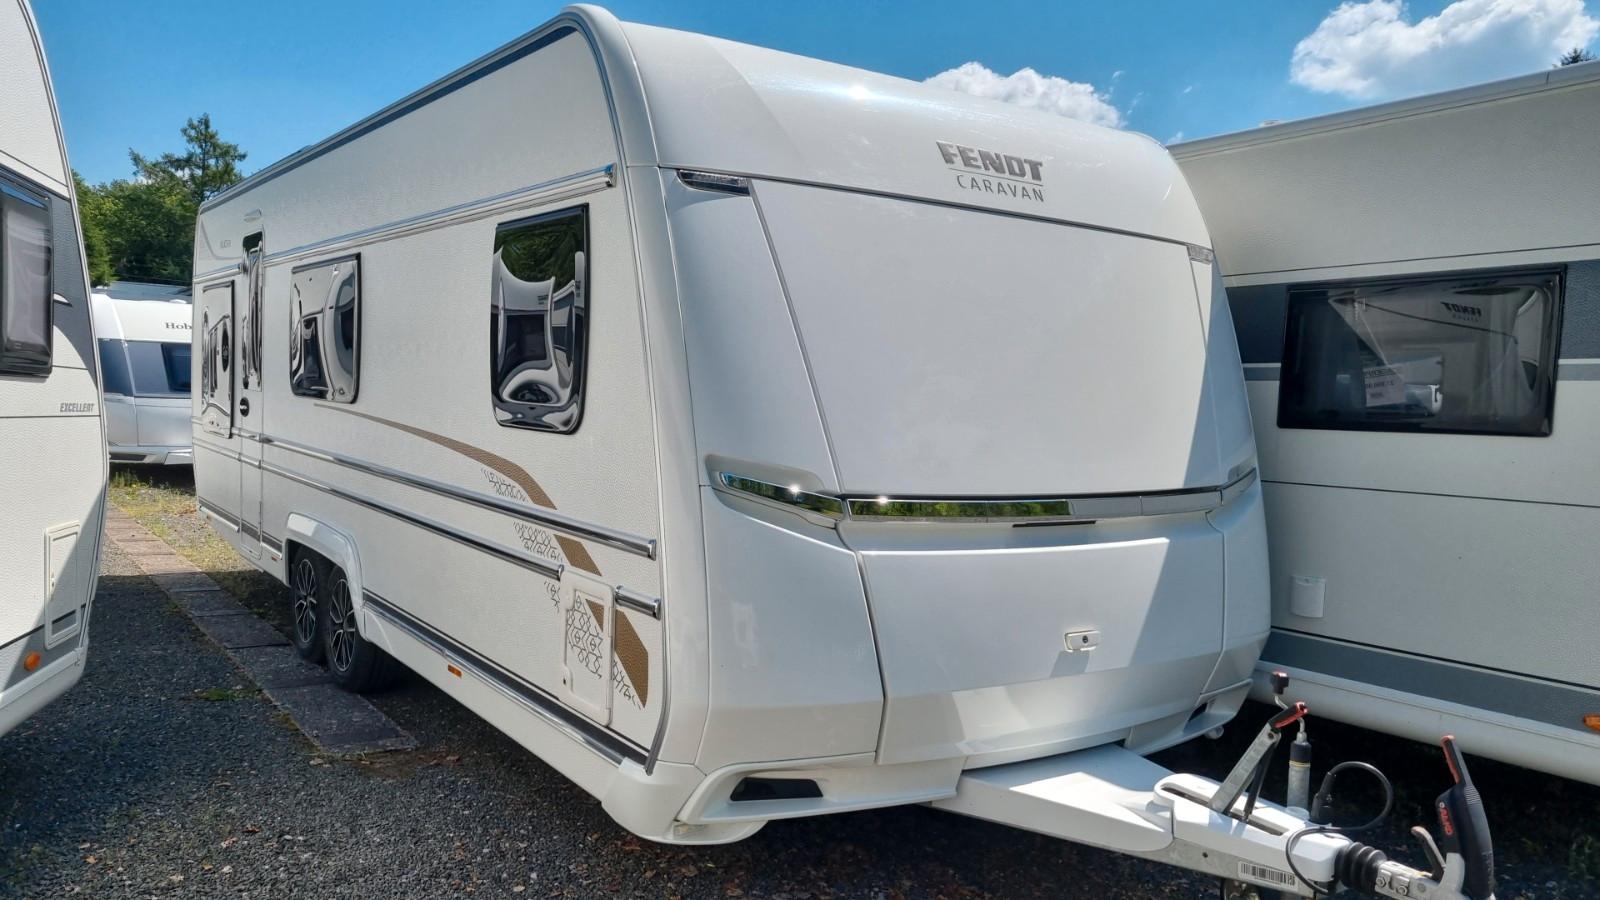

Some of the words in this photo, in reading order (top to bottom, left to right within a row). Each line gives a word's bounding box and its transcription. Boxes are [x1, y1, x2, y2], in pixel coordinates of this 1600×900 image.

[936, 140, 1043, 182] FENDT
[956, 174, 1045, 203] CARAVAN
[60, 402, 94, 413] EXCELLENT
